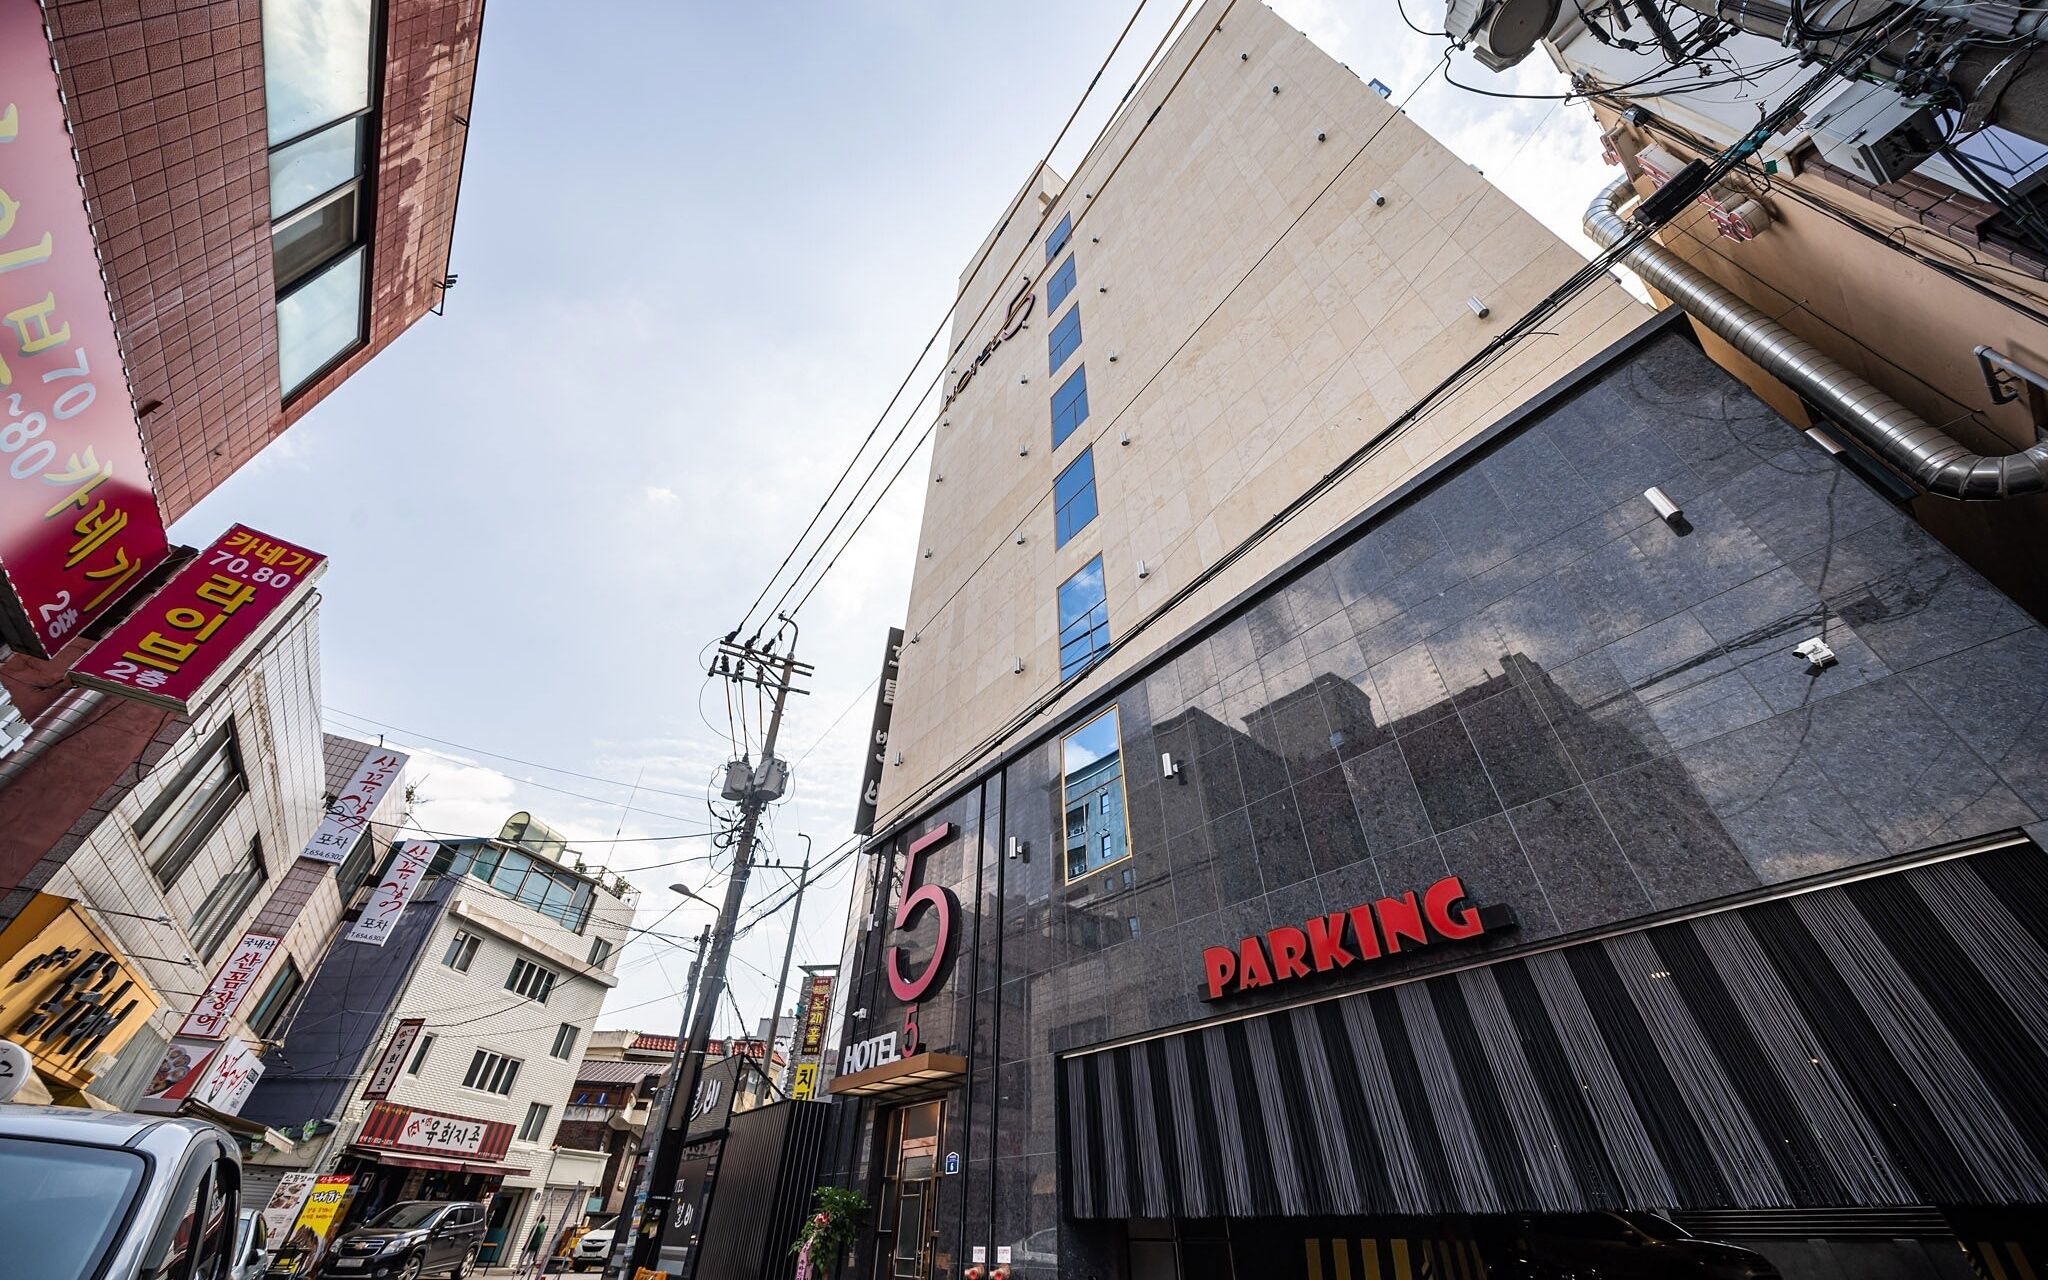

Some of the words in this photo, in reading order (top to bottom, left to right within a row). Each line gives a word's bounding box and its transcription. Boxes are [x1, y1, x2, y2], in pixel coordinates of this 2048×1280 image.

[1001, 279, 1036, 341] 5
[42, 347, 97, 421] 70
[43, 445, 142, 613] 카네기
[224, 531, 314, 576] 카네기
[208, 550, 292, 589] 70.80
[39, 590, 79, 639] 2층
[122, 573, 257, 673] 라이브
[104, 661, 169, 689] 2층
[315, 833, 349, 850] 포차
[360, 918, 389, 930] 포차
[888, 822, 953, 1001] 5
[243, 937, 276, 951] 국내산
[1202, 875, 1485, 998] PARKING
[197, 951, 263, 1032] 산꼼장어
[842, 1031, 902, 1076] HOTEL
[901, 1005, 919, 1058] 5
[425, 1119, 480, 1149] 육회지존
[313, 1190, 343, 1204] 대하
